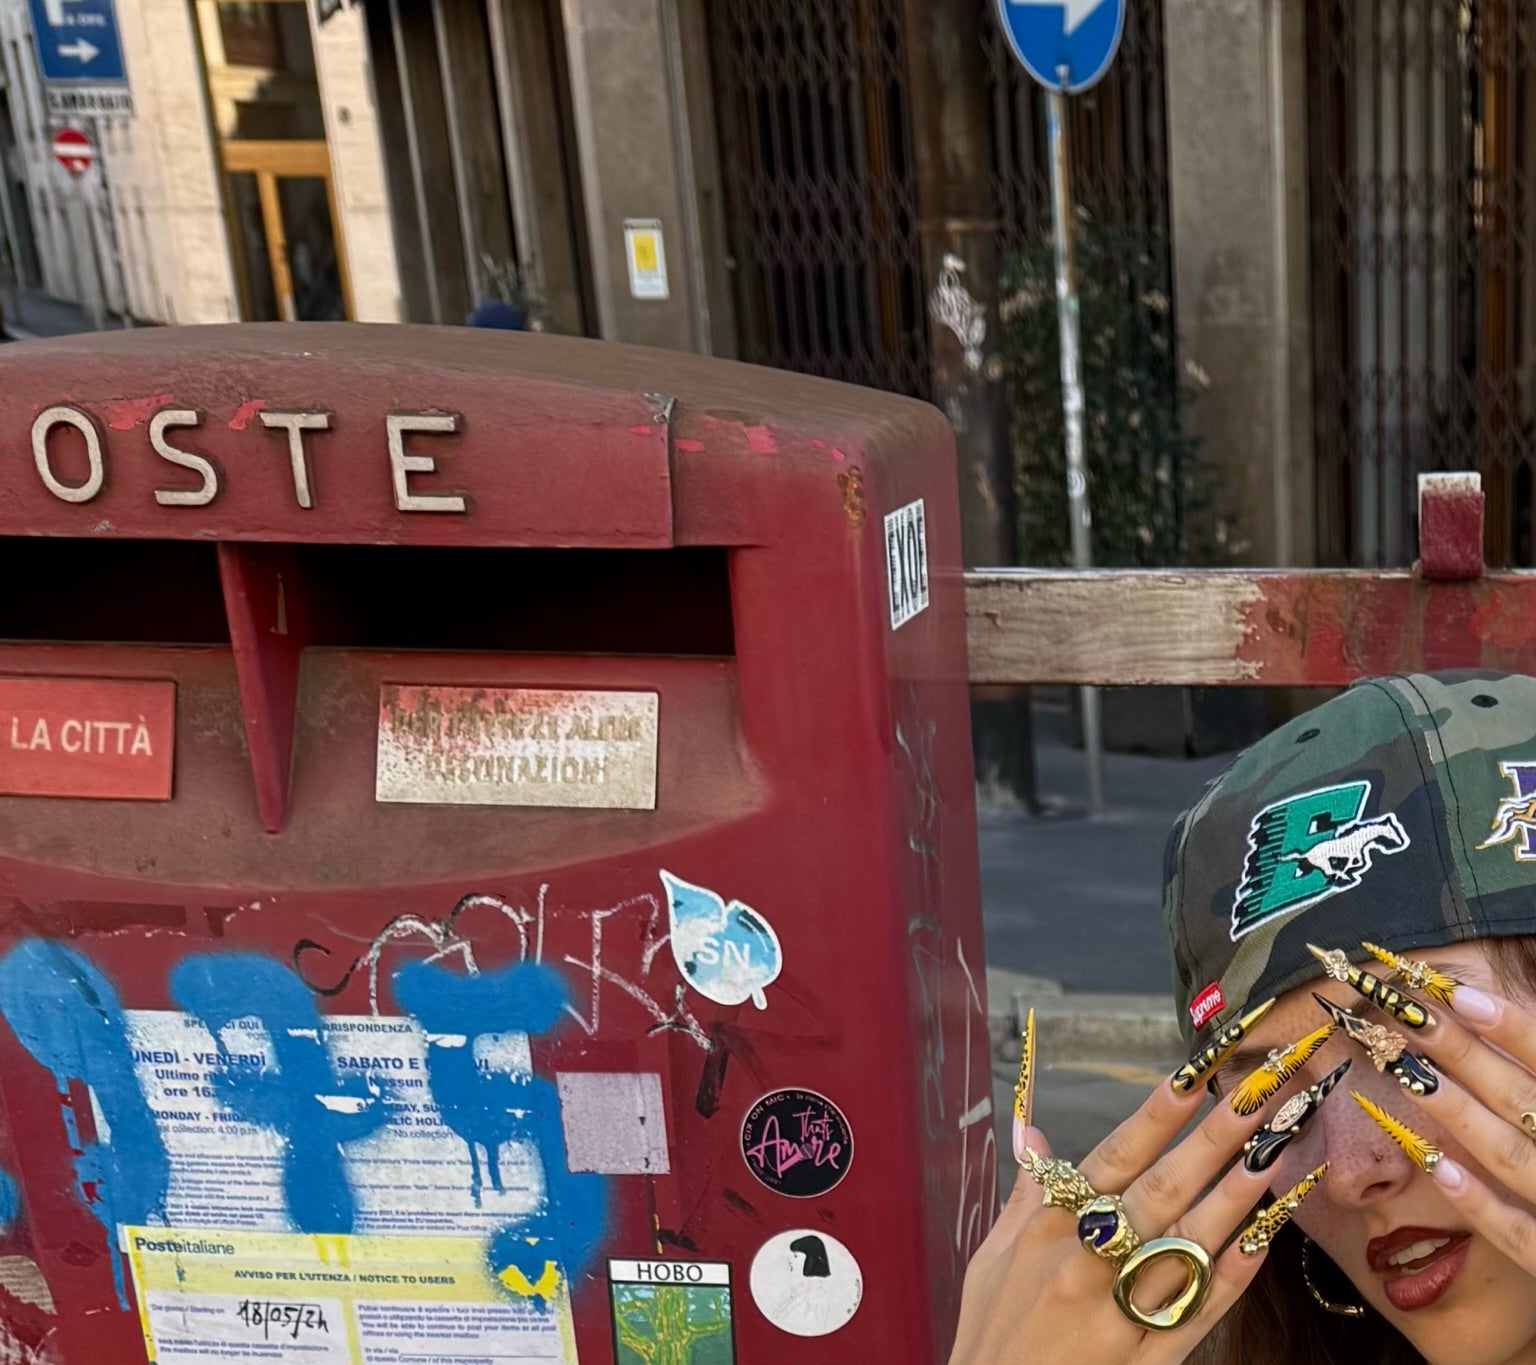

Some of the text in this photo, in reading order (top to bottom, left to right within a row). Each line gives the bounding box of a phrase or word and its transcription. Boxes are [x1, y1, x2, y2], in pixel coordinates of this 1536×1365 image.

[31, 405, 467, 512] OSTE
[11, 713, 153, 757] LA CITTÀ
[696, 937, 751, 970] SN
[135, 1050, 180, 1064] UNEDÌ
[194, 1052, 266, 1067] VENERDÌ
[337, 1057, 404, 1070] SABATO
[155, 1069, 200, 1081] Ultimo
[163, 1087, 188, 1097] ore
[751, 1104, 764, 1120] ON
[765, 1094, 786, 1107] MIC
[134, 1236, 235, 1255] Posteitaliane
[234, 1269, 273, 1279] AVVISO
[276, 1271, 297, 1281] PER
[299, 1272, 351, 1282] L'UTENZA
[359, 1274, 400, 1284] NOTICE
[402, 1275, 416, 1284] TO
[419, 1276, 456, 1285] USERS
[636, 1263, 704, 1282] HOBO
